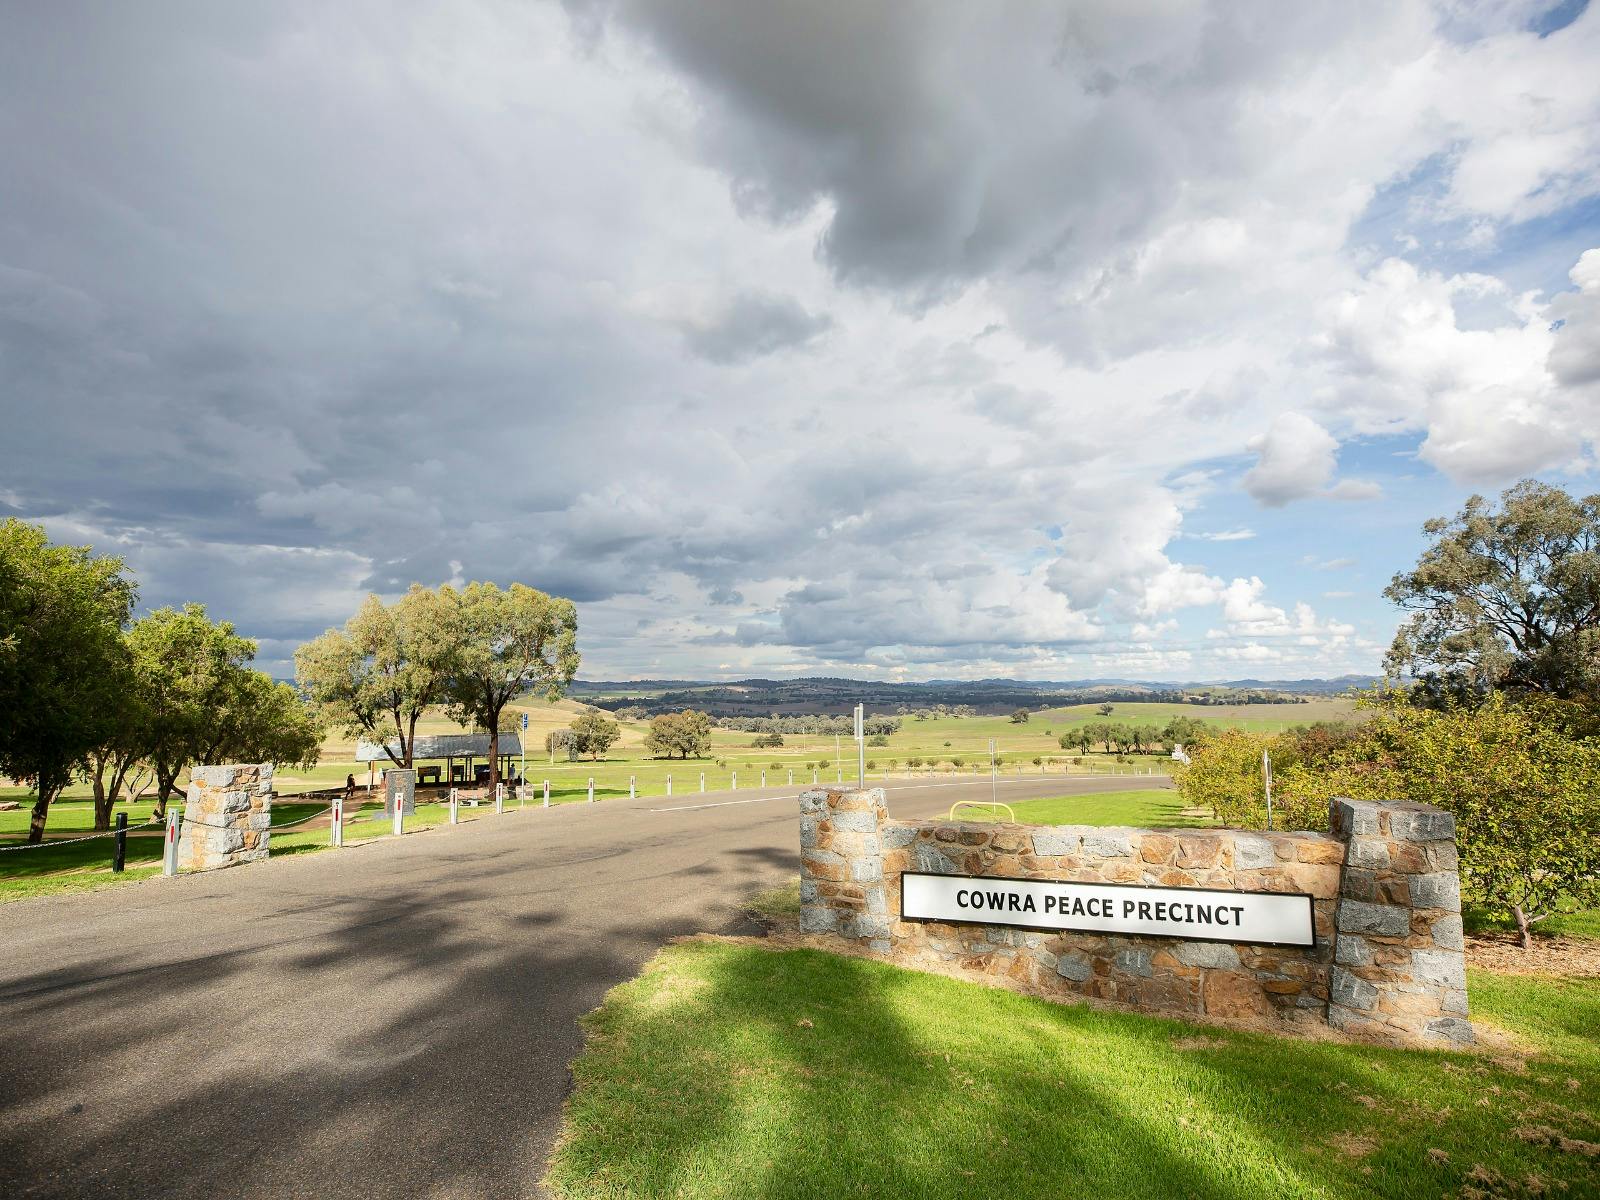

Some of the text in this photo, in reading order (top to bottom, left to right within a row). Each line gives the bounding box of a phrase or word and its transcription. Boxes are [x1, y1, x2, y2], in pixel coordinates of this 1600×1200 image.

[956, 889, 1245, 926] COWRA PEACE PRECINCT
